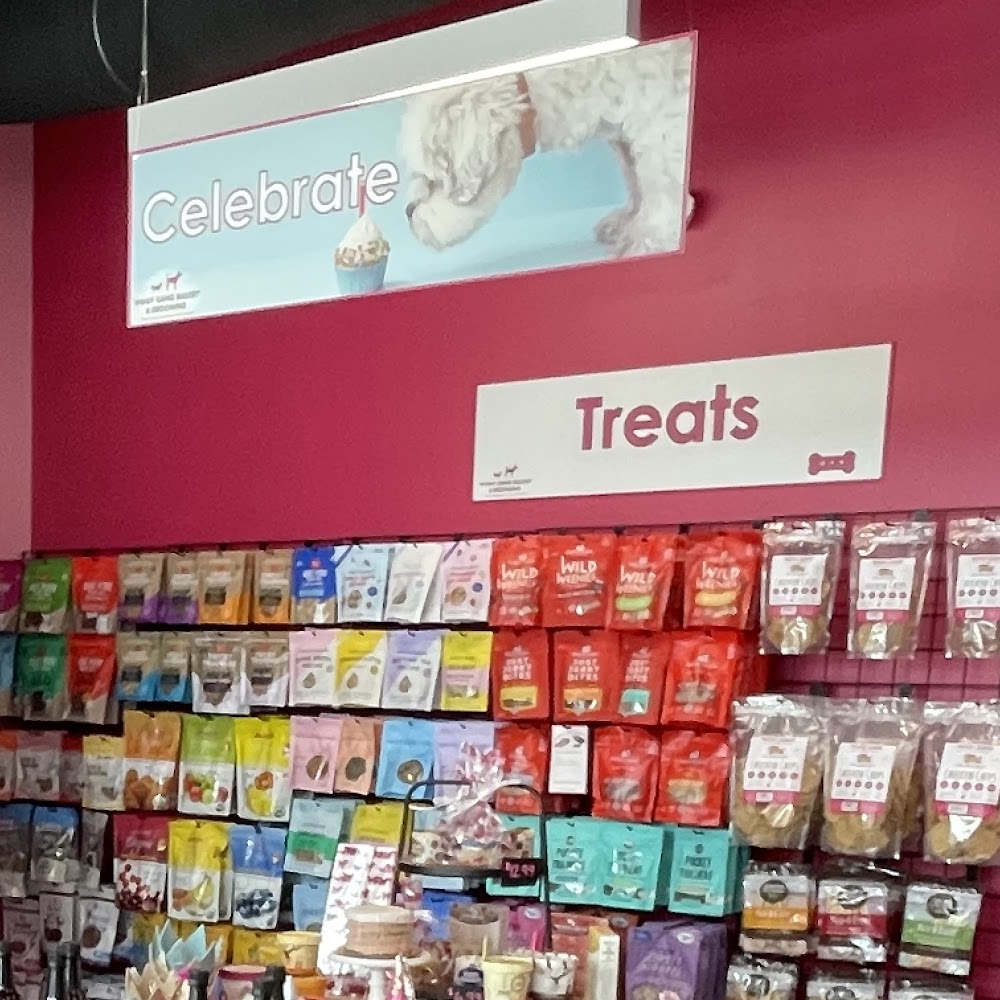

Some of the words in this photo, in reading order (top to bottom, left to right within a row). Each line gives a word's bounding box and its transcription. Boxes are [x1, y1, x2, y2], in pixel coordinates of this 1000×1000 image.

[142, 152, 400, 243] Celebrate
[575, 384, 760, 451] Treats
[501, 563, 539, 580] WILD
[561, 555, 598, 575] WILD
[621, 565, 657, 585] WILD
[702, 561, 740, 581] WILD
